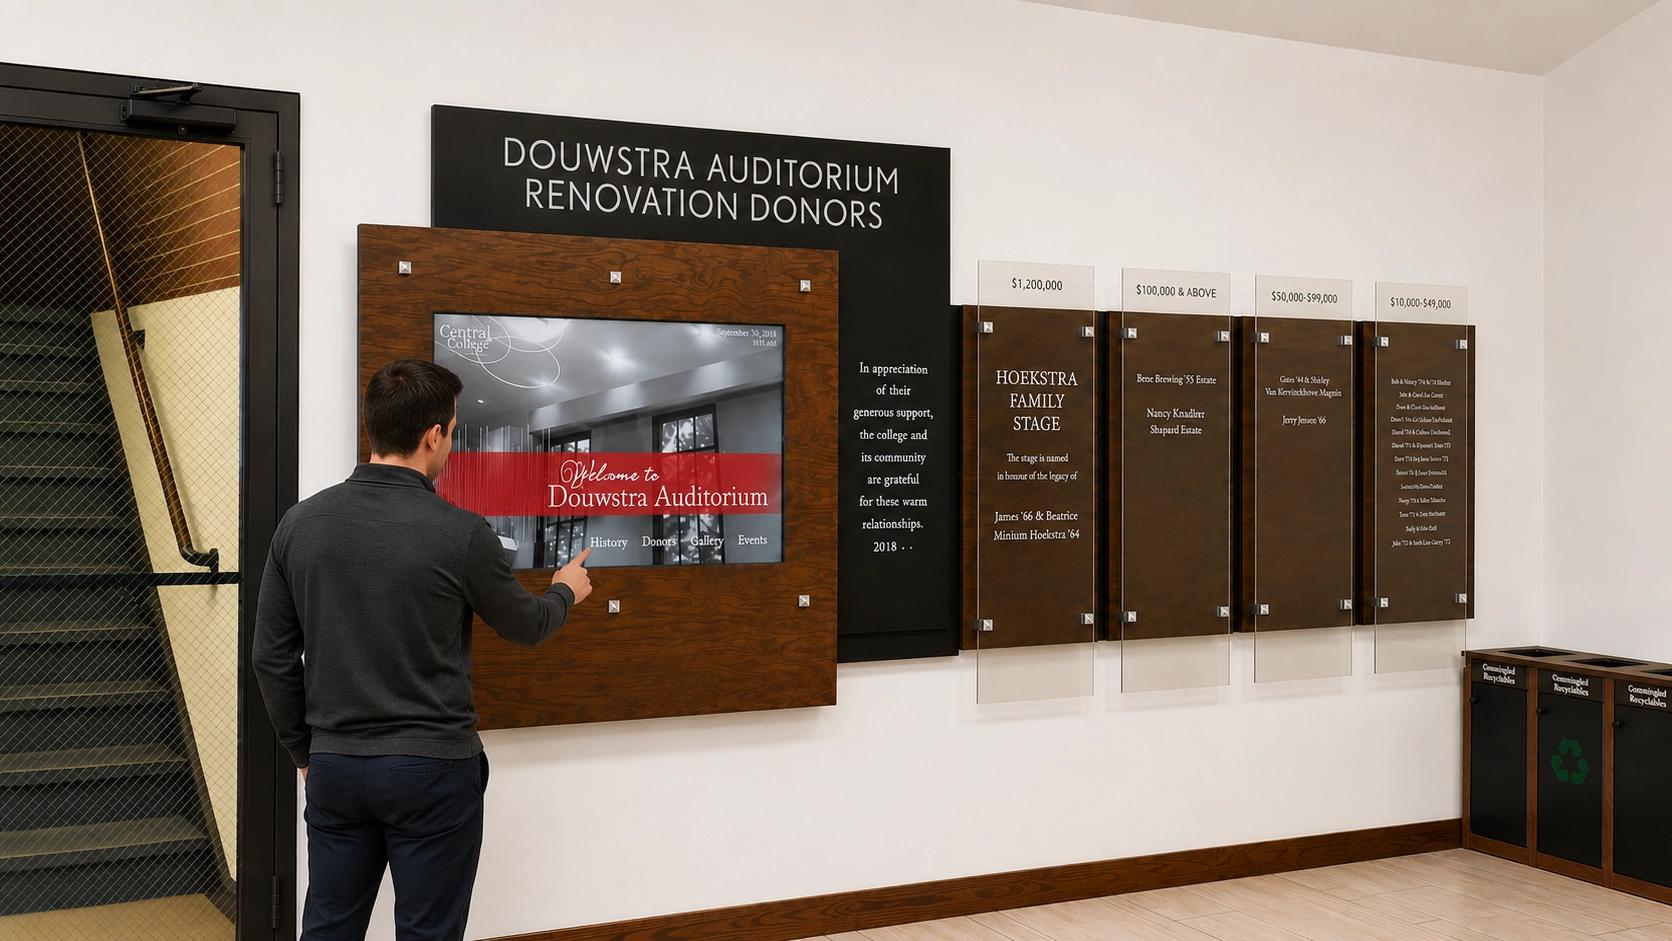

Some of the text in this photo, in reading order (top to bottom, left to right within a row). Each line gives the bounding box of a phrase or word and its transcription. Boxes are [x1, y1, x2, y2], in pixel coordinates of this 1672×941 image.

[504, 137, 898, 194] DOUWSTRA AUDITORIUM
[526, 178, 883, 229] RENOVATION DONORS
[1012, 277, 1063, 291] $1,200,000
[1136, 284, 1217, 299] $100,000 & ABOVE
[1271, 290, 1338, 304] $50,000-$99,000
[1390, 297, 1451, 309] $10,000-$49,000
[440, 324, 490, 338] Central
[447, 337, 490, 353] College
[859, 362, 928, 377] In appreciation
[996, 370, 1078, 386] HOEKSTRA
[1155, 374, 1183, 386] Brewing
[1196, 375, 1217, 384] Estate
[876, 384, 912, 396] of their
[1009, 393, 1065, 409] FAMILY
[853, 408, 934, 420] generous support,
[1146, 408, 1171, 420] Nancy
[1013, 416, 1061, 431] STAGE
[1181, 425, 1202, 435] Estate
[859, 430, 928, 444] the college and
[861, 452, 927, 465] its community
[1006, 453, 1019, 463] The
[1020, 454, 1038, 465] stage
[1046, 453, 1069, 463] named
[561, 459, 660, 489] Welcome to
[867, 473, 920, 487] are grateful
[1028, 471, 1037, 481] of
[1037, 471, 1048, 481] the
[1070, 470, 1078, 481] of
[548, 484, 769, 509] Douwstra Auditorium
[859, 495, 928, 507] for these warm
[994, 511, 1019, 523] James
[1035, 511, 1044, 521] &
[1046, 510, 1079, 521] Beatrice
[862, 518, 924, 532] relationships.
[590, 534, 768, 550] History Donors Gallery Events
[994, 530, 1028, 541] Minium
[1029, 529, 1067, 541] Hoekstra
[873, 541, 897, 552] 2018
